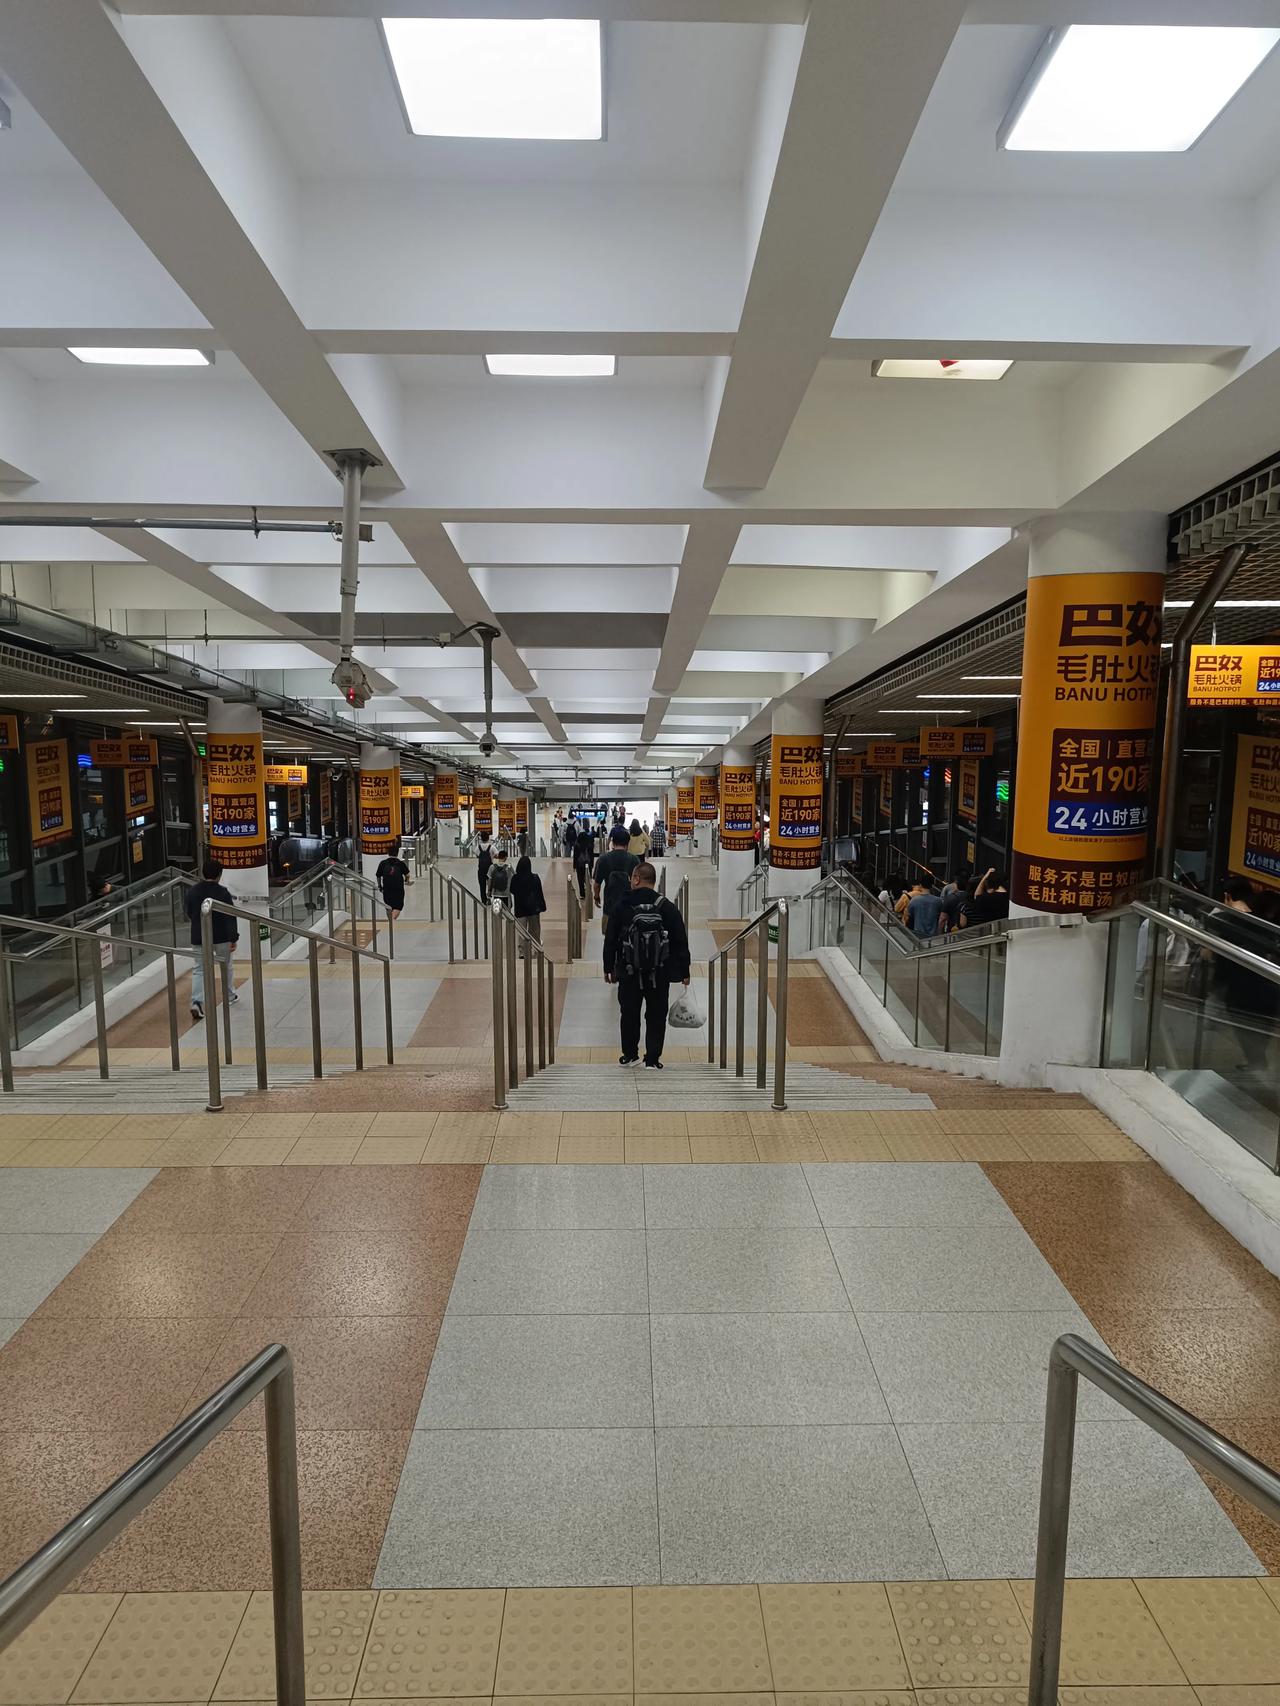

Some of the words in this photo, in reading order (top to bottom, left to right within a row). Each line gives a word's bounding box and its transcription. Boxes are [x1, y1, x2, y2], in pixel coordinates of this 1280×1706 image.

[1195, 655, 1243, 672] 巴奴
[1194, 675, 1242, 685] 毛肚火锅
[1055, 687, 1108, 701] BANU
[209, 744, 256, 762] 巴奴
[781, 746, 822, 763] 巴奴
[1059, 738, 1101, 758] 全国
[361, 776, 389, 787] 巴奴
[725, 772, 753, 783] 巴奴
[212, 807, 256, 821] 近190家
[781, 808, 820, 821] 近190家
[213, 824, 257, 835] 24小时营业
[780, 825, 820, 836] 24小时营业
